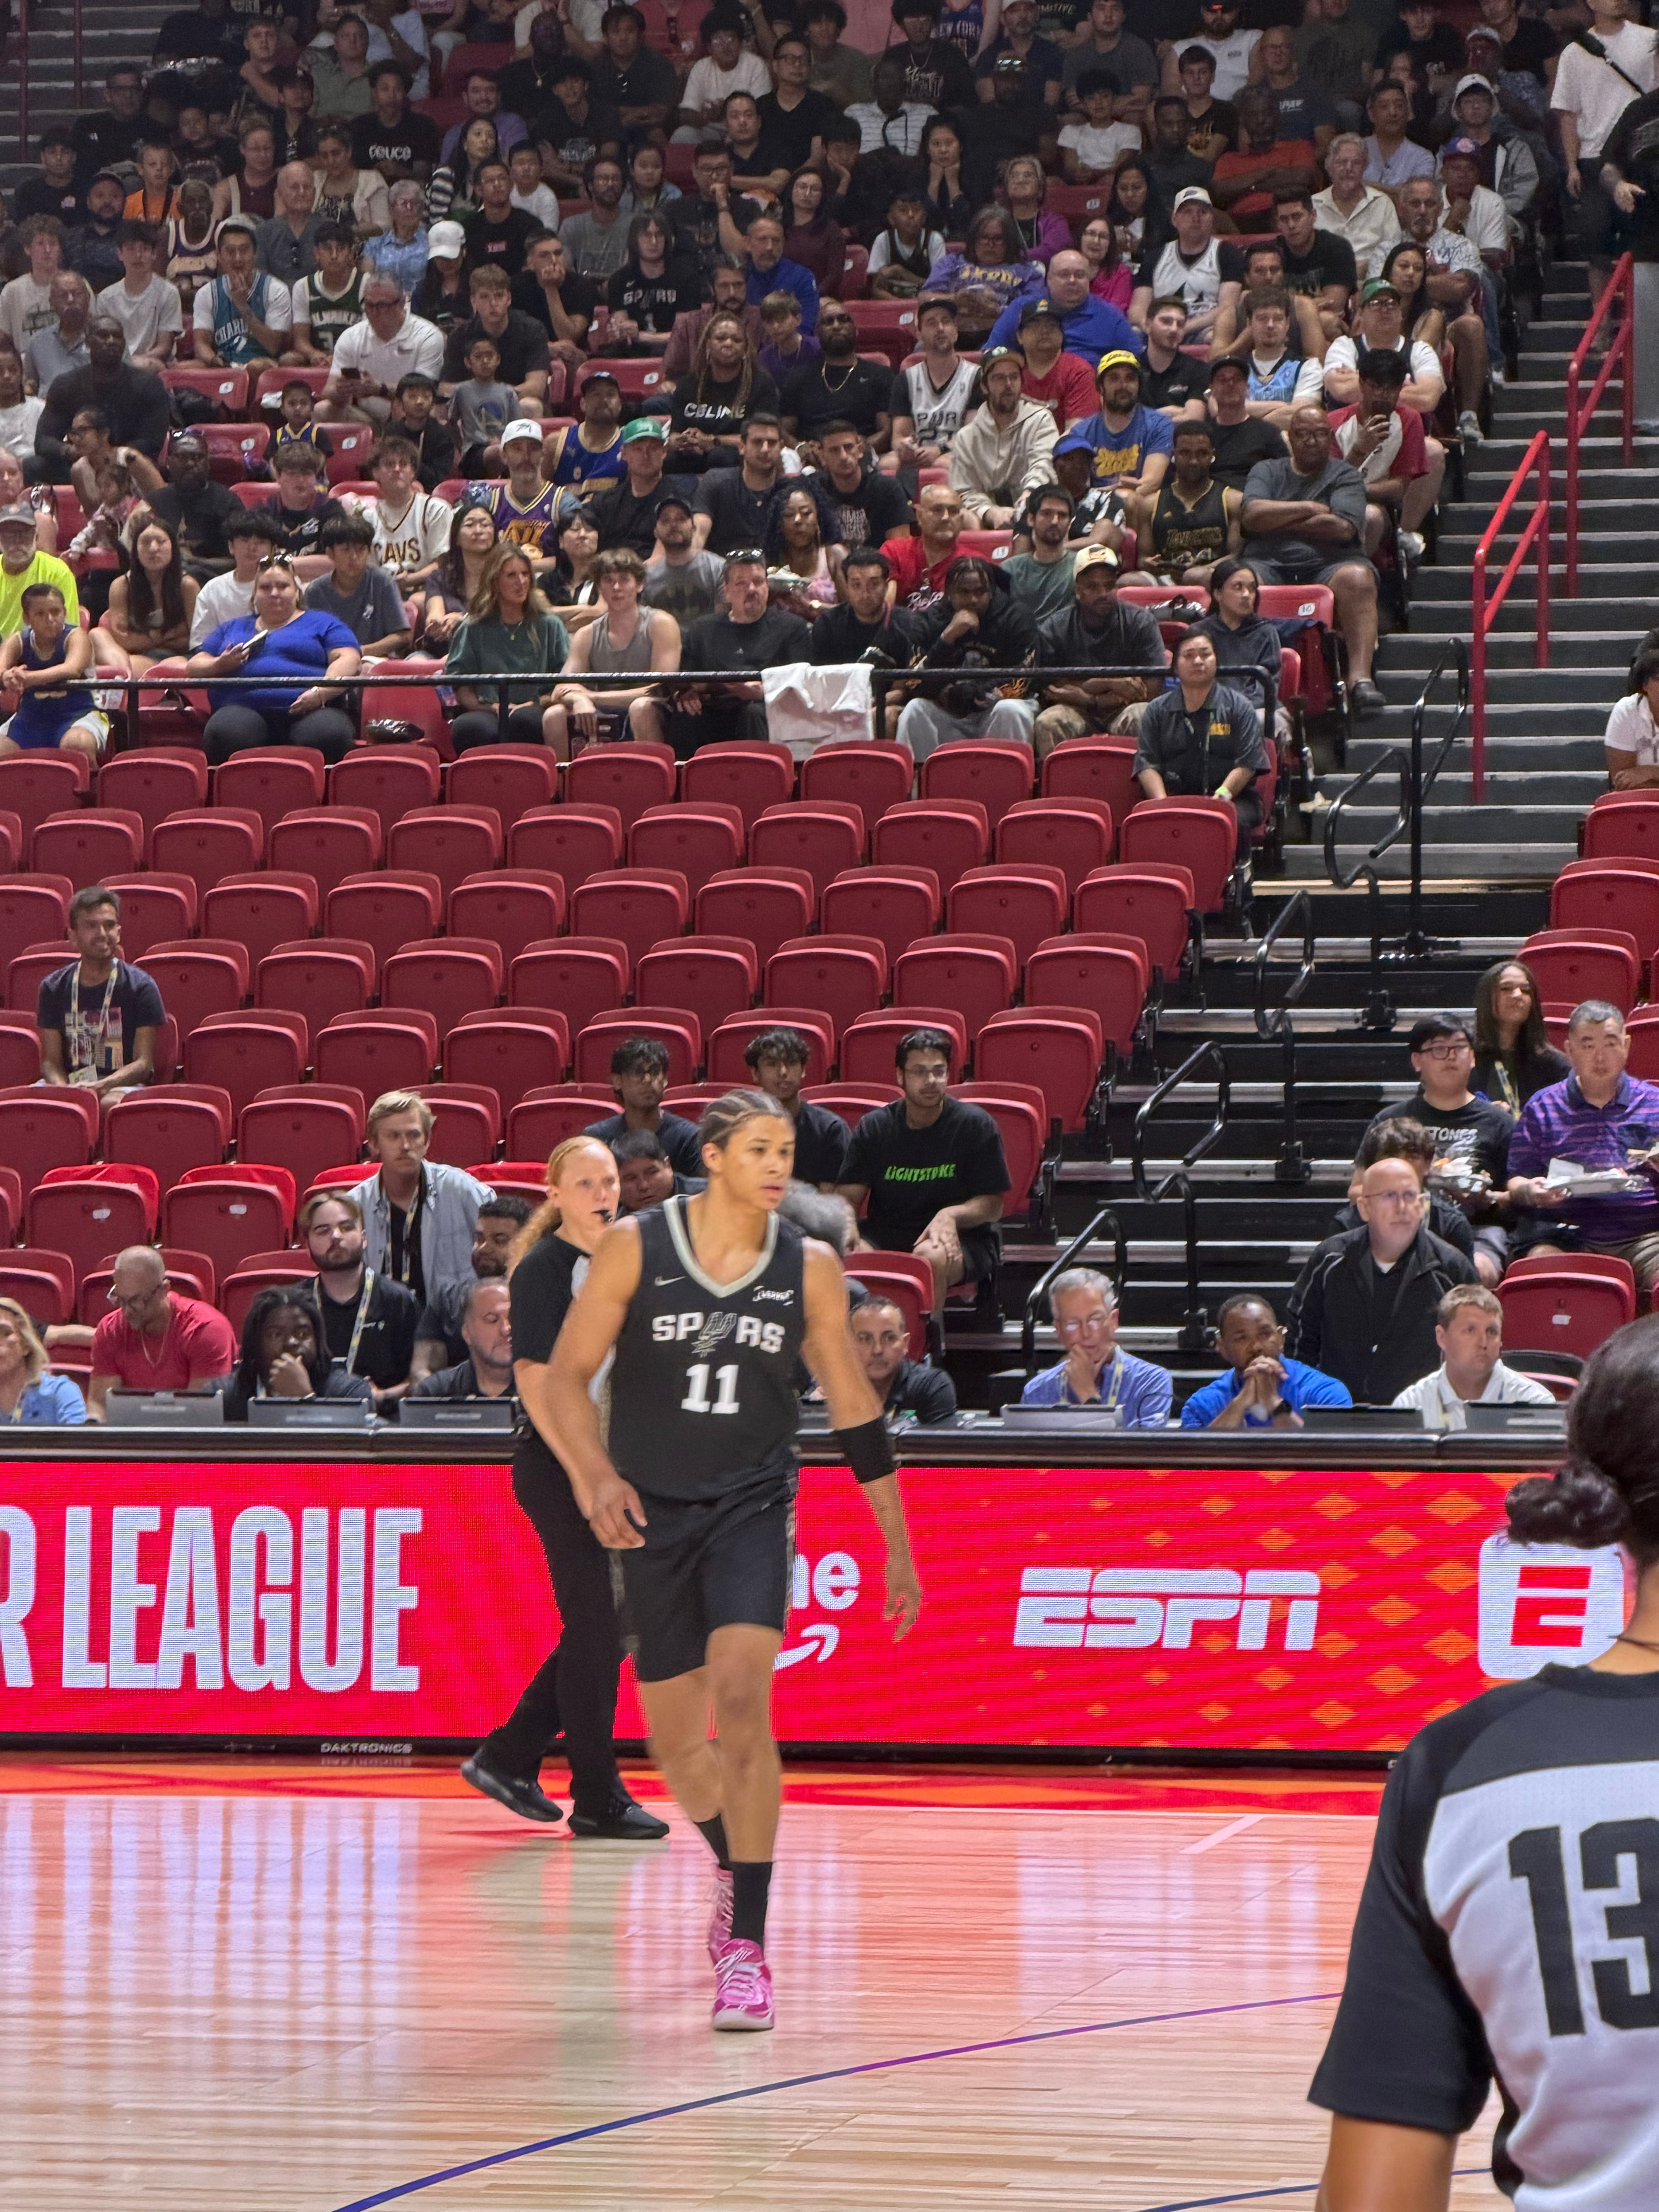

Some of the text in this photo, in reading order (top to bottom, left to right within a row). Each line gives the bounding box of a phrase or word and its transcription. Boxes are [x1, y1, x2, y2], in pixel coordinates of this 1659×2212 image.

[374, 538, 421, 566] CAVS
[1426, 1126, 1478, 1141] TONES
[653, 1312, 785, 1356] SPURS
[681, 1364, 740, 1415] 11
[62, 1506, 423, 1693] LEAGUE
[1013, 1567, 1322, 1651] ESPN
[321, 1743, 413, 1753] DAKTRONICS
[1508, 1817, 1659, 2036] 13
